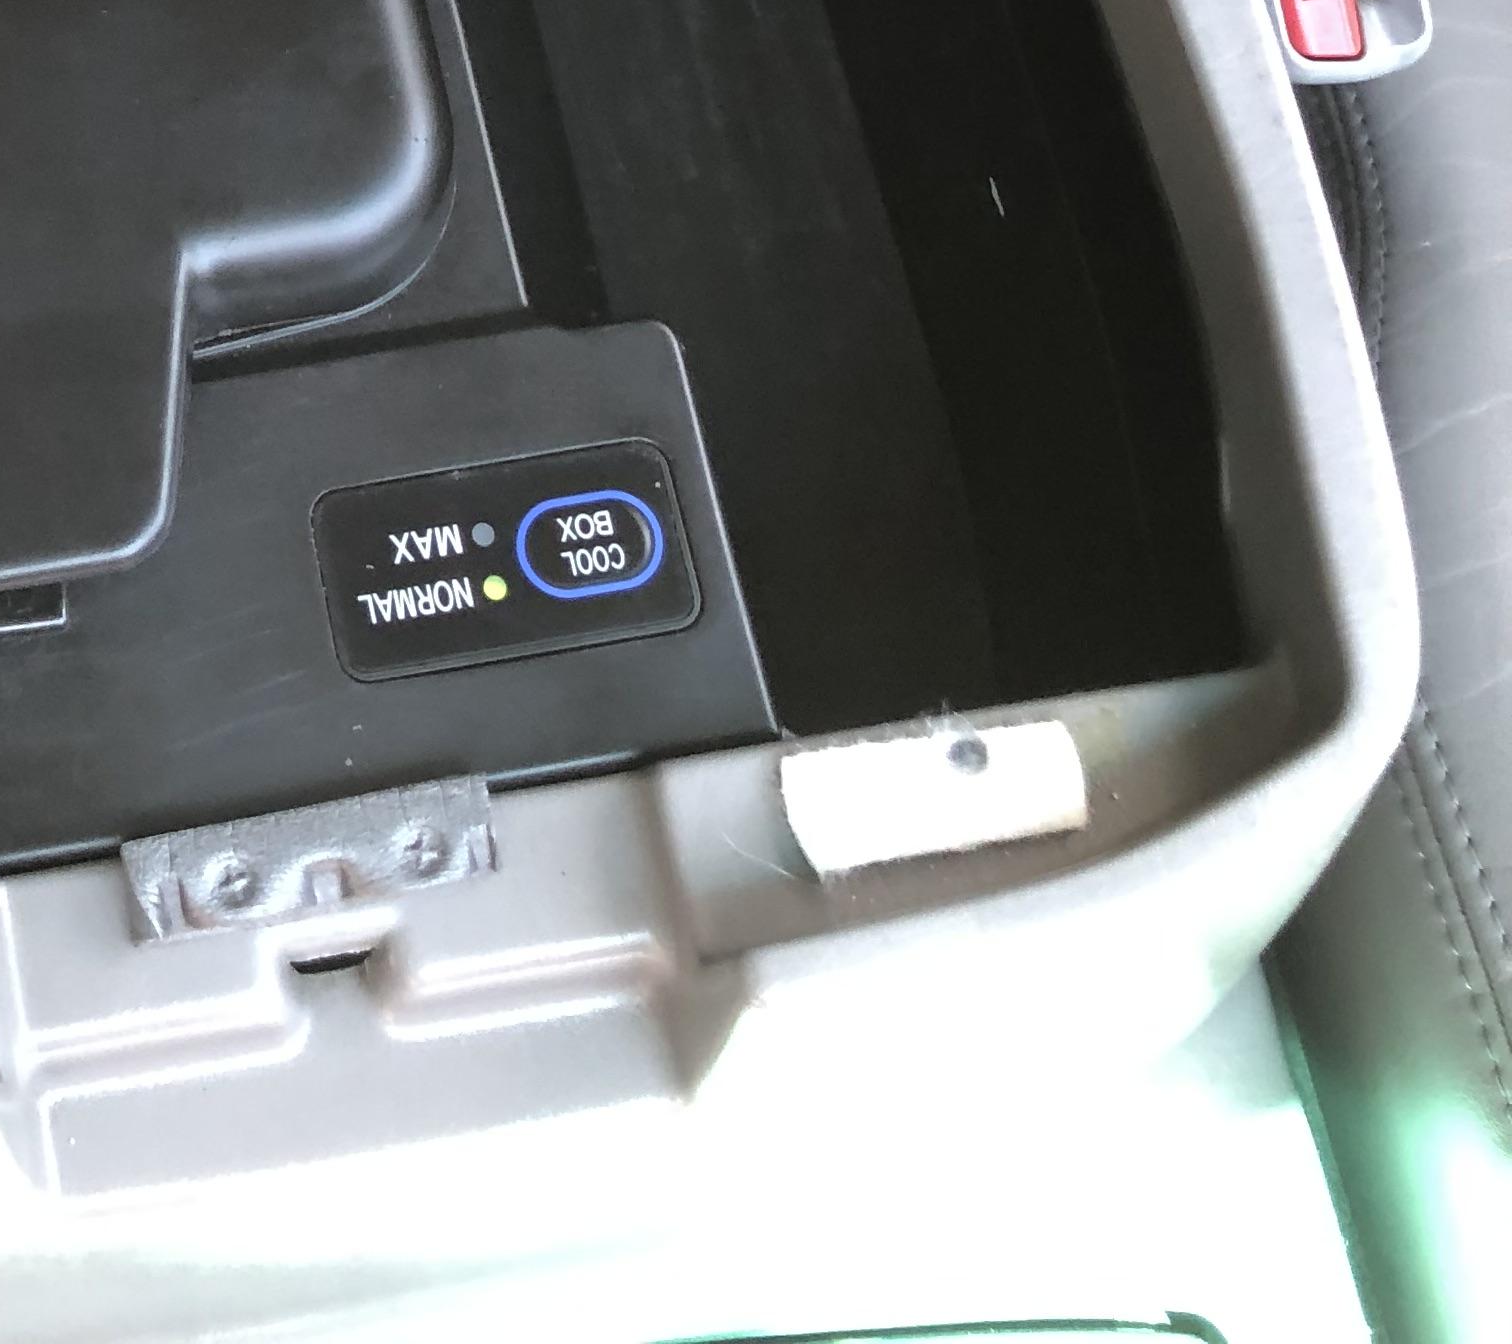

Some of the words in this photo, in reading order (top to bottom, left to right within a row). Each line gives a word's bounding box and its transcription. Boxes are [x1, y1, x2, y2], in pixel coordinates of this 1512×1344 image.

[390, 524, 463, 564] MAX
[556, 511, 613, 542] BOX
[561, 543, 624, 576] COOL
[358, 577, 474, 624] NORMAL
